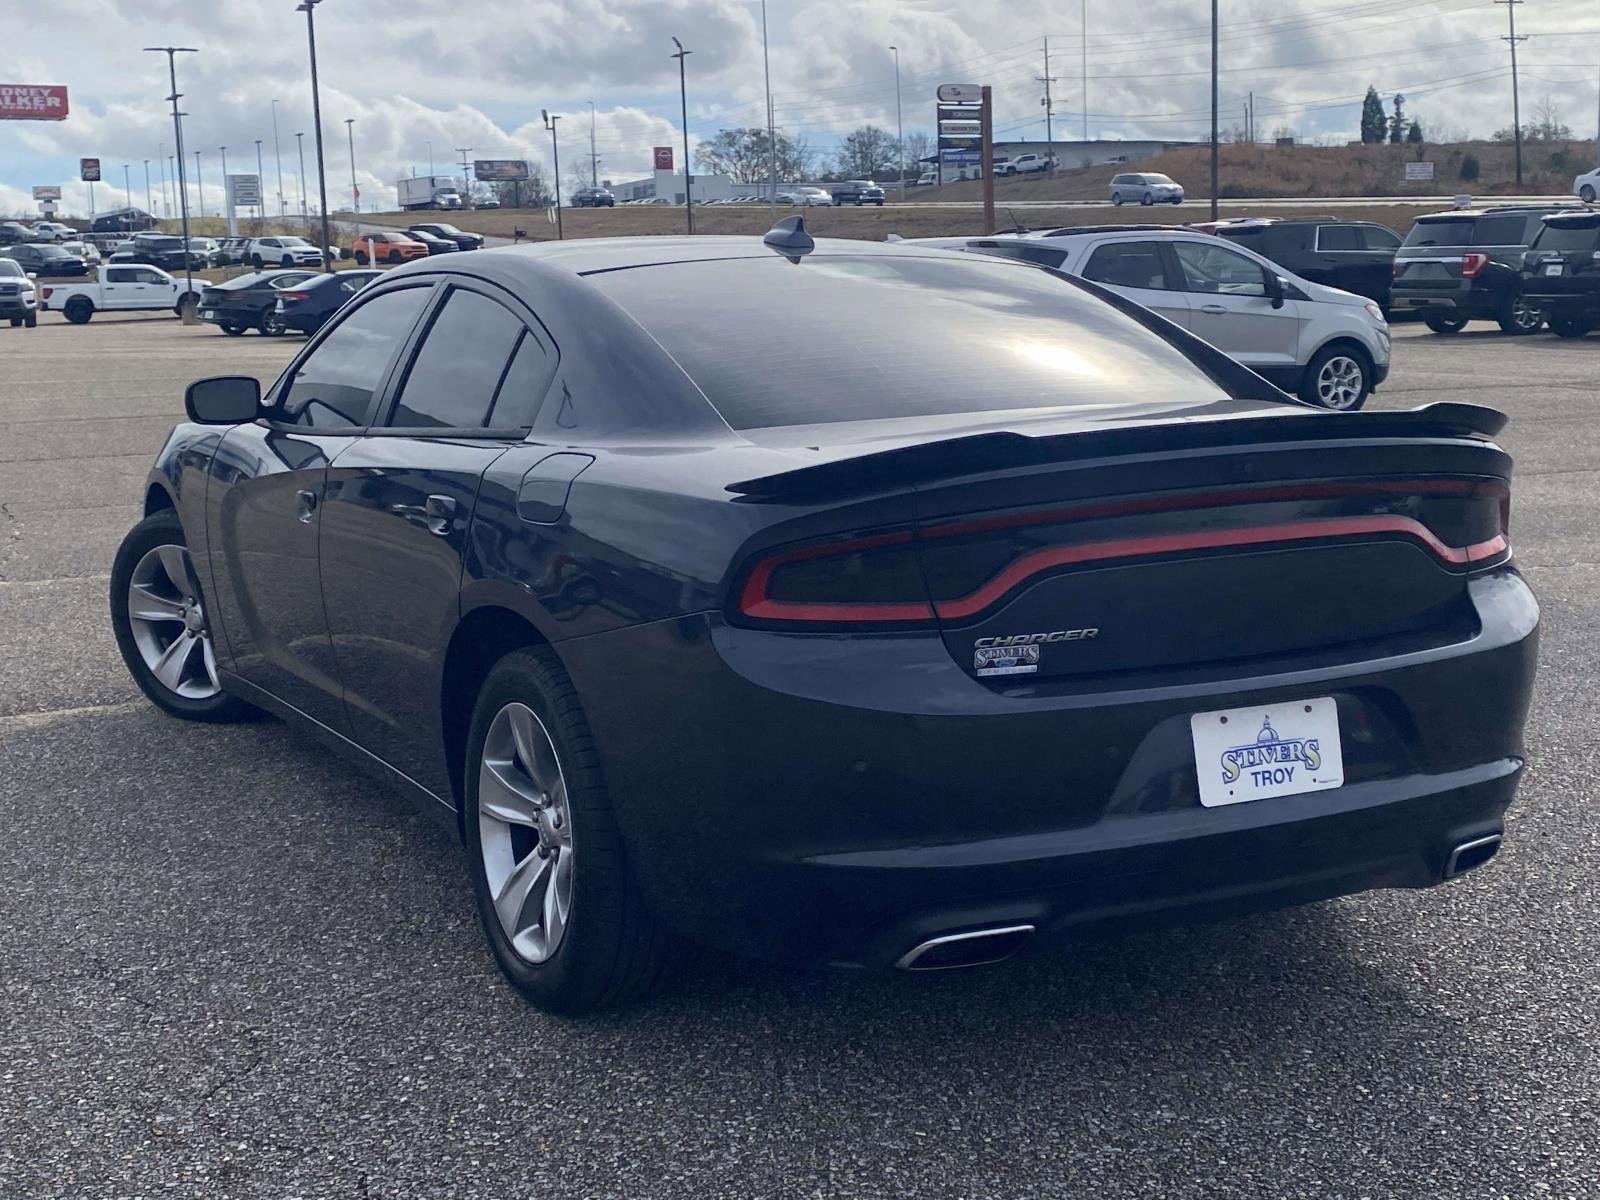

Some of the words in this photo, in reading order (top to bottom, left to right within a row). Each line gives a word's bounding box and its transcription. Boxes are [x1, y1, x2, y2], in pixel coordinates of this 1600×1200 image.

[974, 628, 1099, 648] CHARGER
[975, 644, 1039, 668] STIVERS
[1221, 739, 1321, 784] STIVERS
[1251, 767, 1295, 787] TROY
